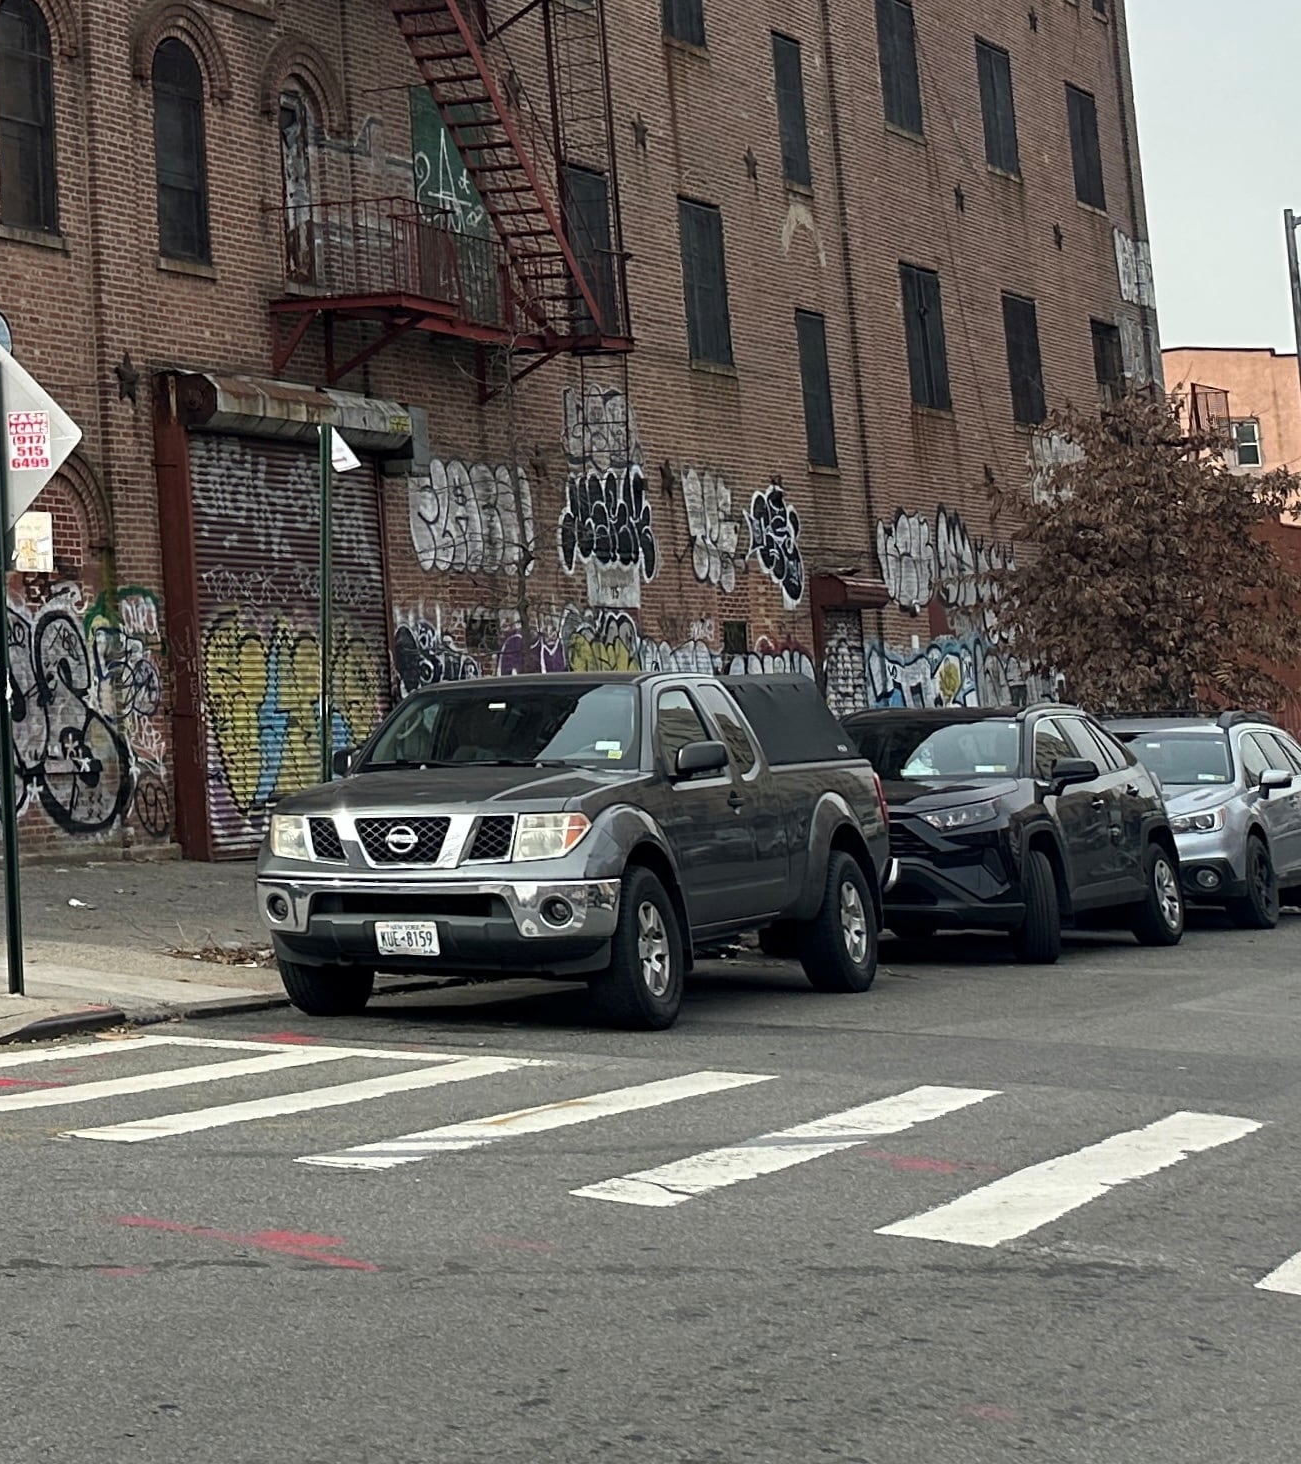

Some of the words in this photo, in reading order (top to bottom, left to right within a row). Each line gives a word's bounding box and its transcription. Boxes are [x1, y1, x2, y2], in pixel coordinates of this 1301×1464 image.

[12, 435, 46, 446] (917)
[17, 446, 44, 456] 515
[12, 457, 49, 468] 6499
